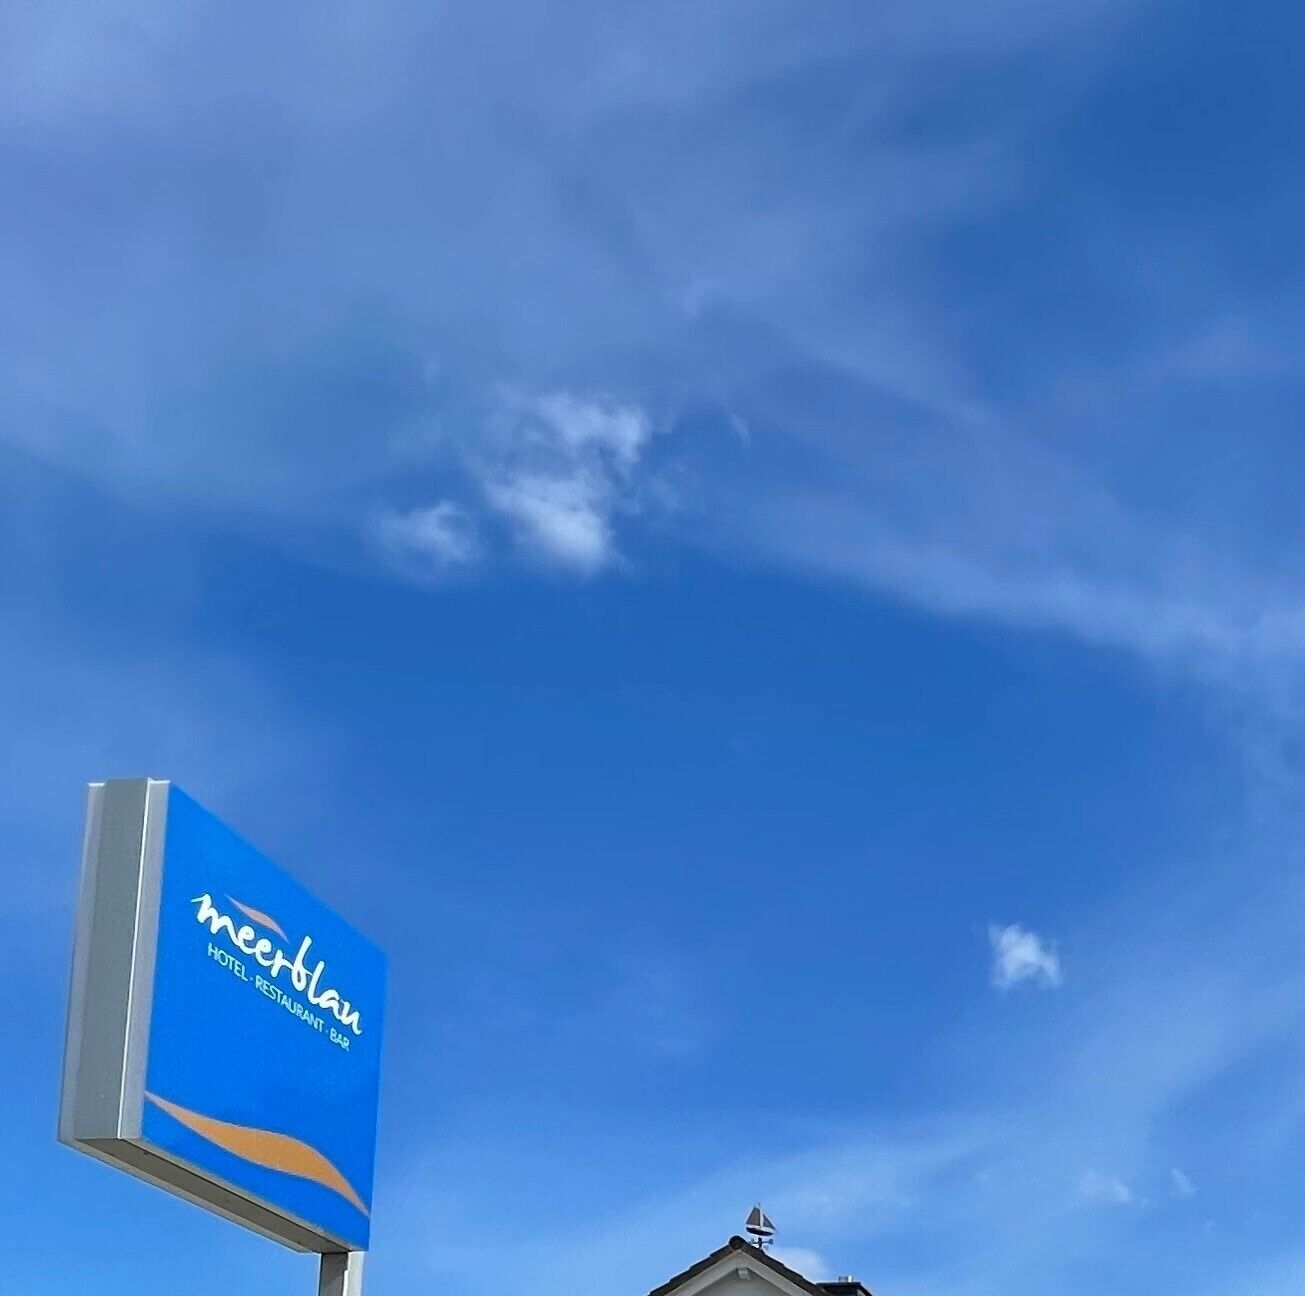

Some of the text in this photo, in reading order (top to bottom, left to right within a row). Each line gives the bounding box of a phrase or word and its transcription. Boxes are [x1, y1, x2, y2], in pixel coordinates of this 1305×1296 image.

[191, 893, 362, 1035] meerblau
[207, 942, 350, 1053] HOTEL RESTAURANT BAR
